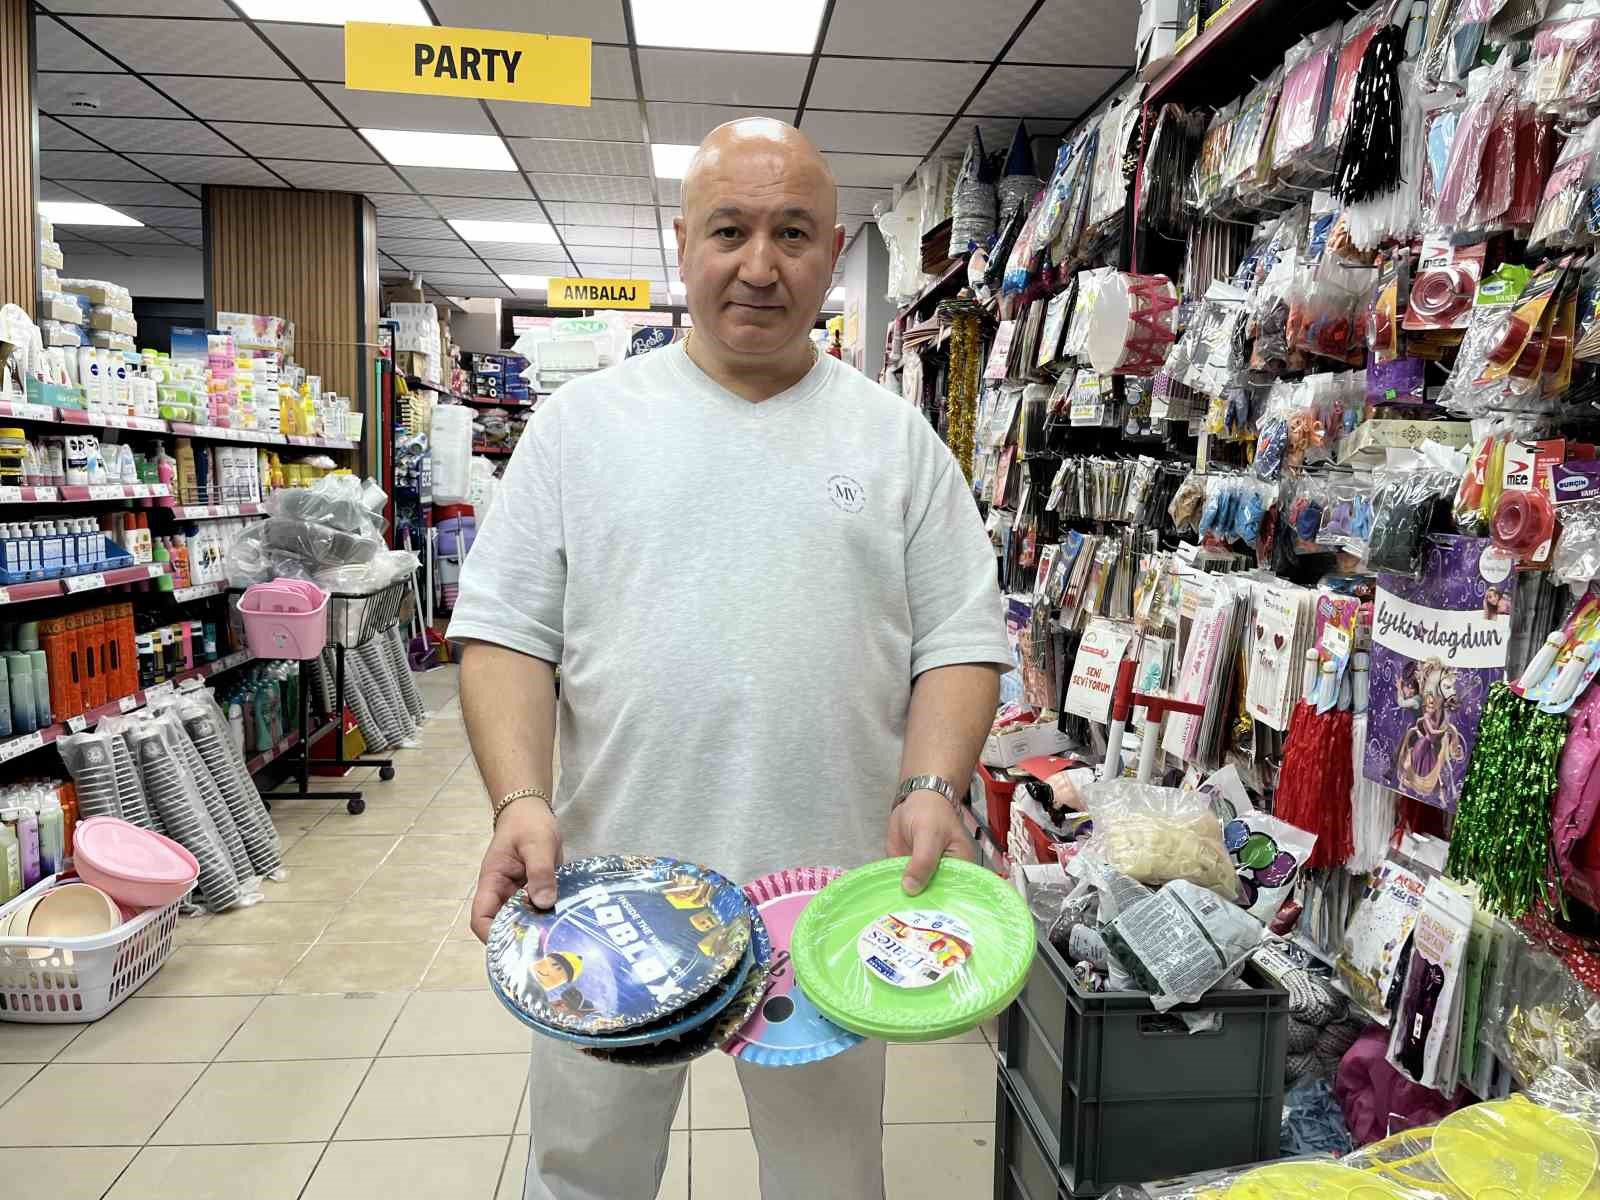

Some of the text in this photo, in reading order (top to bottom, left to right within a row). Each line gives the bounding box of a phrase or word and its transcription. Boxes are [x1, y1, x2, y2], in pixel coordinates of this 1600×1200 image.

[413, 43, 522, 83] PARTY
[564, 285, 636, 301] AMBALAJ
[639, 919, 656, 938] THE
